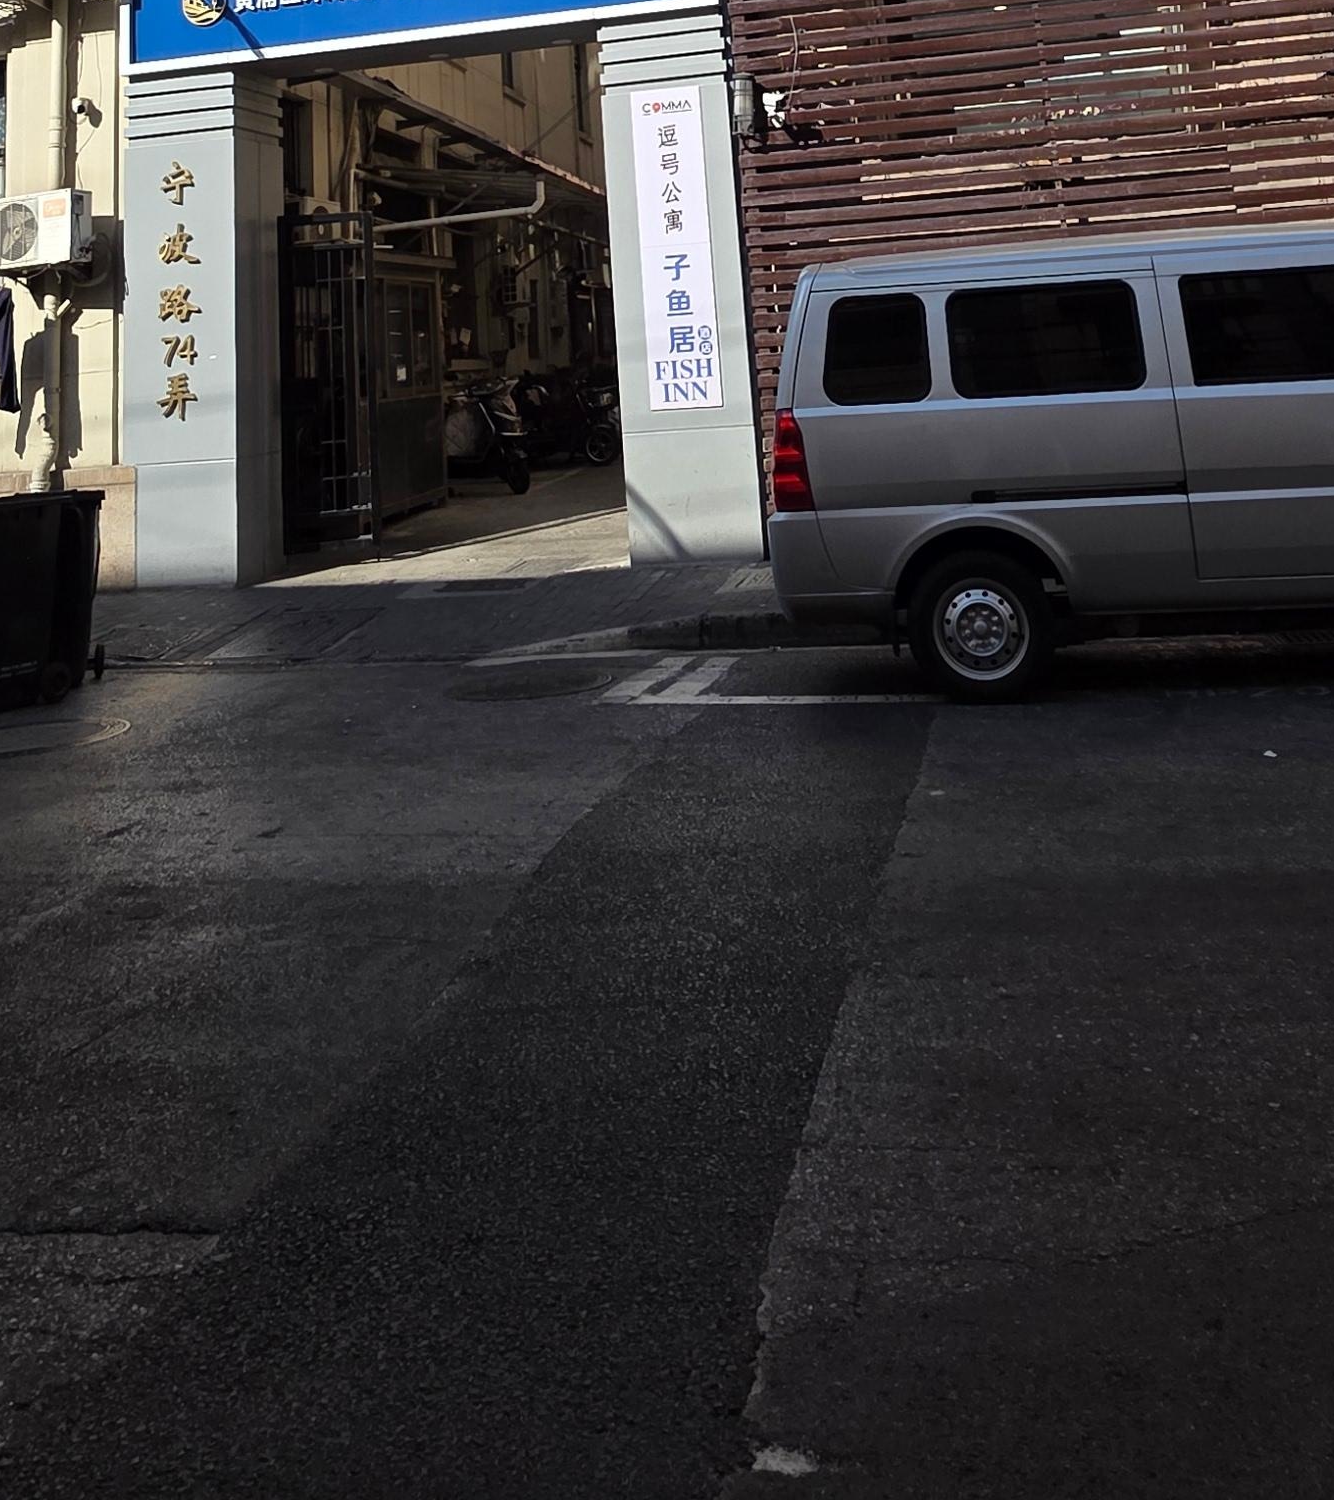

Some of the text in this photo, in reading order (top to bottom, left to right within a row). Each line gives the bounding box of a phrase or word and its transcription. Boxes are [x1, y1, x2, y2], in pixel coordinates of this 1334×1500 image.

[658, 124, 683, 234] 逗号公寓
[156, 161, 202, 421] 宁波路74弄
[664, 254, 695, 354] 子鱼居
[654, 358, 714, 381] FISH
[662, 381, 709, 403] INN
